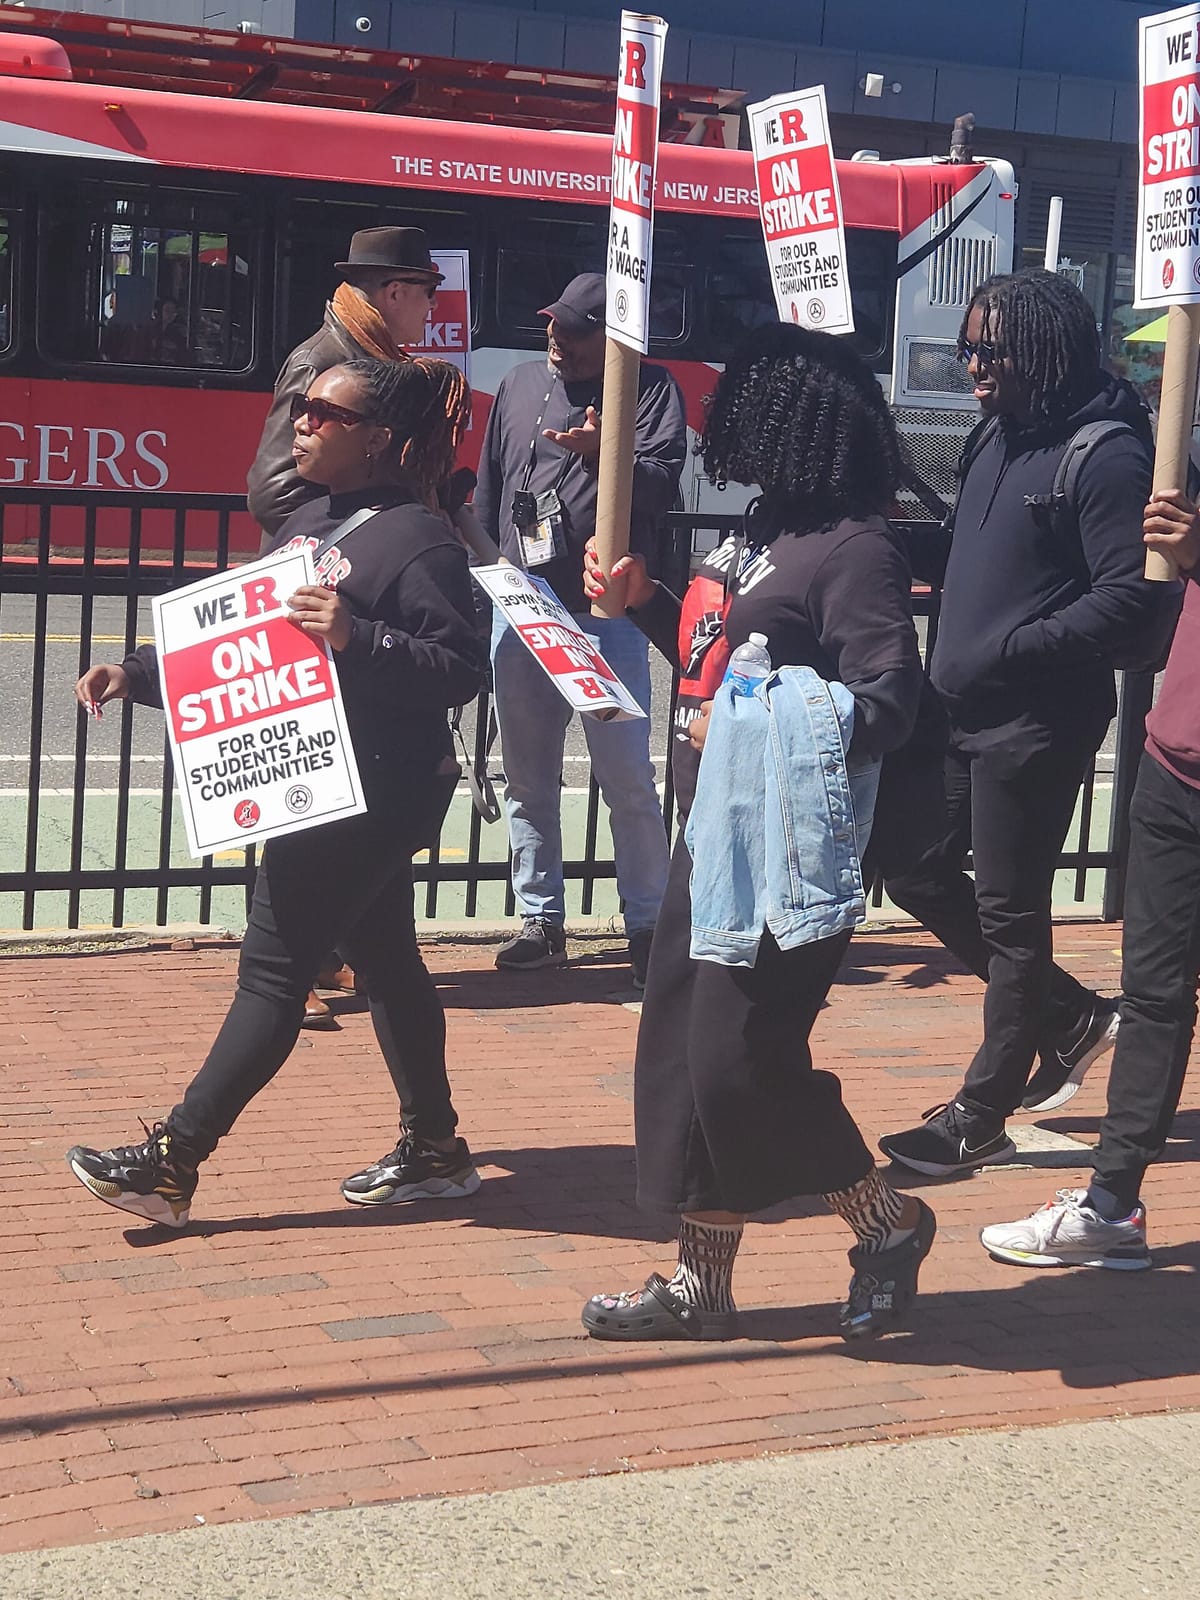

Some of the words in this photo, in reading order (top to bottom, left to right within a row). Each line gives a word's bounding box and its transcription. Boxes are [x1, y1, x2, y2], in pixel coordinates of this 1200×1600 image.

[624, 40, 646, 89] R
[1166, 30, 1193, 65] WE
[764, 119, 779, 146] WE
[779, 108, 808, 145] R
[391, 155, 433, 177] THE
[439, 160, 502, 184] STATE
[663, 181, 709, 202] NEW
[771, 158, 801, 197] ON
[763, 188, 835, 235] STRIKE
[1164, 188, 1182, 209] FOR
[620, 226, 630, 250] A
[780, 246, 793, 261] FOR
[793, 241, 818, 258] OUR
[615, 250, 646, 284] WAGE
[775, 260, 811, 279] STUDENTS
[814, 255, 840, 273] AND
[780, 273, 839, 295] COMMUNITIES
[194, 592, 238, 629] WE
[241, 576, 282, 619] R
[211, 630, 273, 679] ON
[178, 655, 327, 732] STRIKE
[573, 677, 607, 699] R
[191, 743, 292, 785] STUDENTS
[295, 729, 337, 757] AND
[218, 732, 256, 758] FOR
[260, 719, 301, 746] OUR
[201, 750, 335, 801] COMMUNITIES
